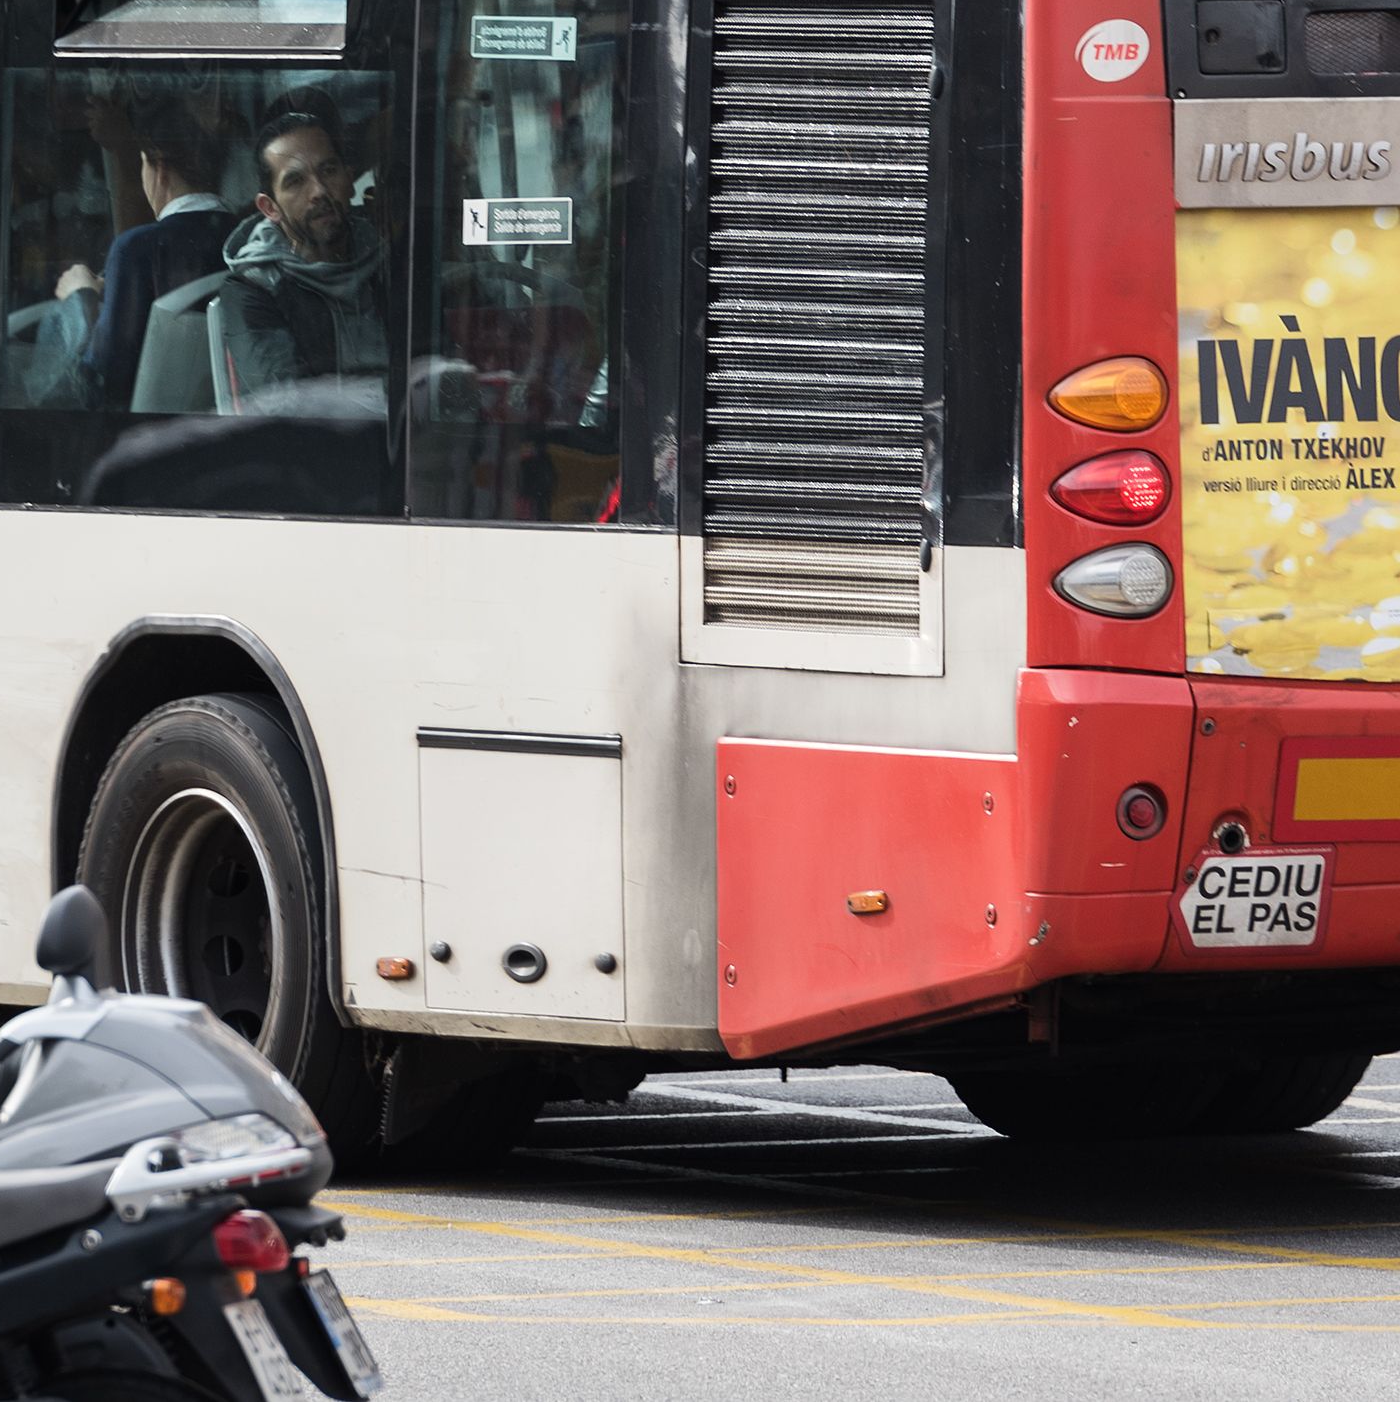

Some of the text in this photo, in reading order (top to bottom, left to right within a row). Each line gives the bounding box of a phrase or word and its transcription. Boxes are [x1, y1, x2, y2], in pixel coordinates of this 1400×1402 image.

[1093, 44, 1140, 61] TMB
[1198, 132, 1393, 183] irisbus
[1202, 438, 1284, 463] d'ANTON
[1203, 476, 1242, 493] versió
[1245, 474, 1278, 492] lliure
[1290, 472, 1341, 491] direcció
[1345, 462, 1395, 489] ÀLEX
[1198, 864, 1322, 900] CEDIU
[1192, 901, 1317, 934] EL PAS
